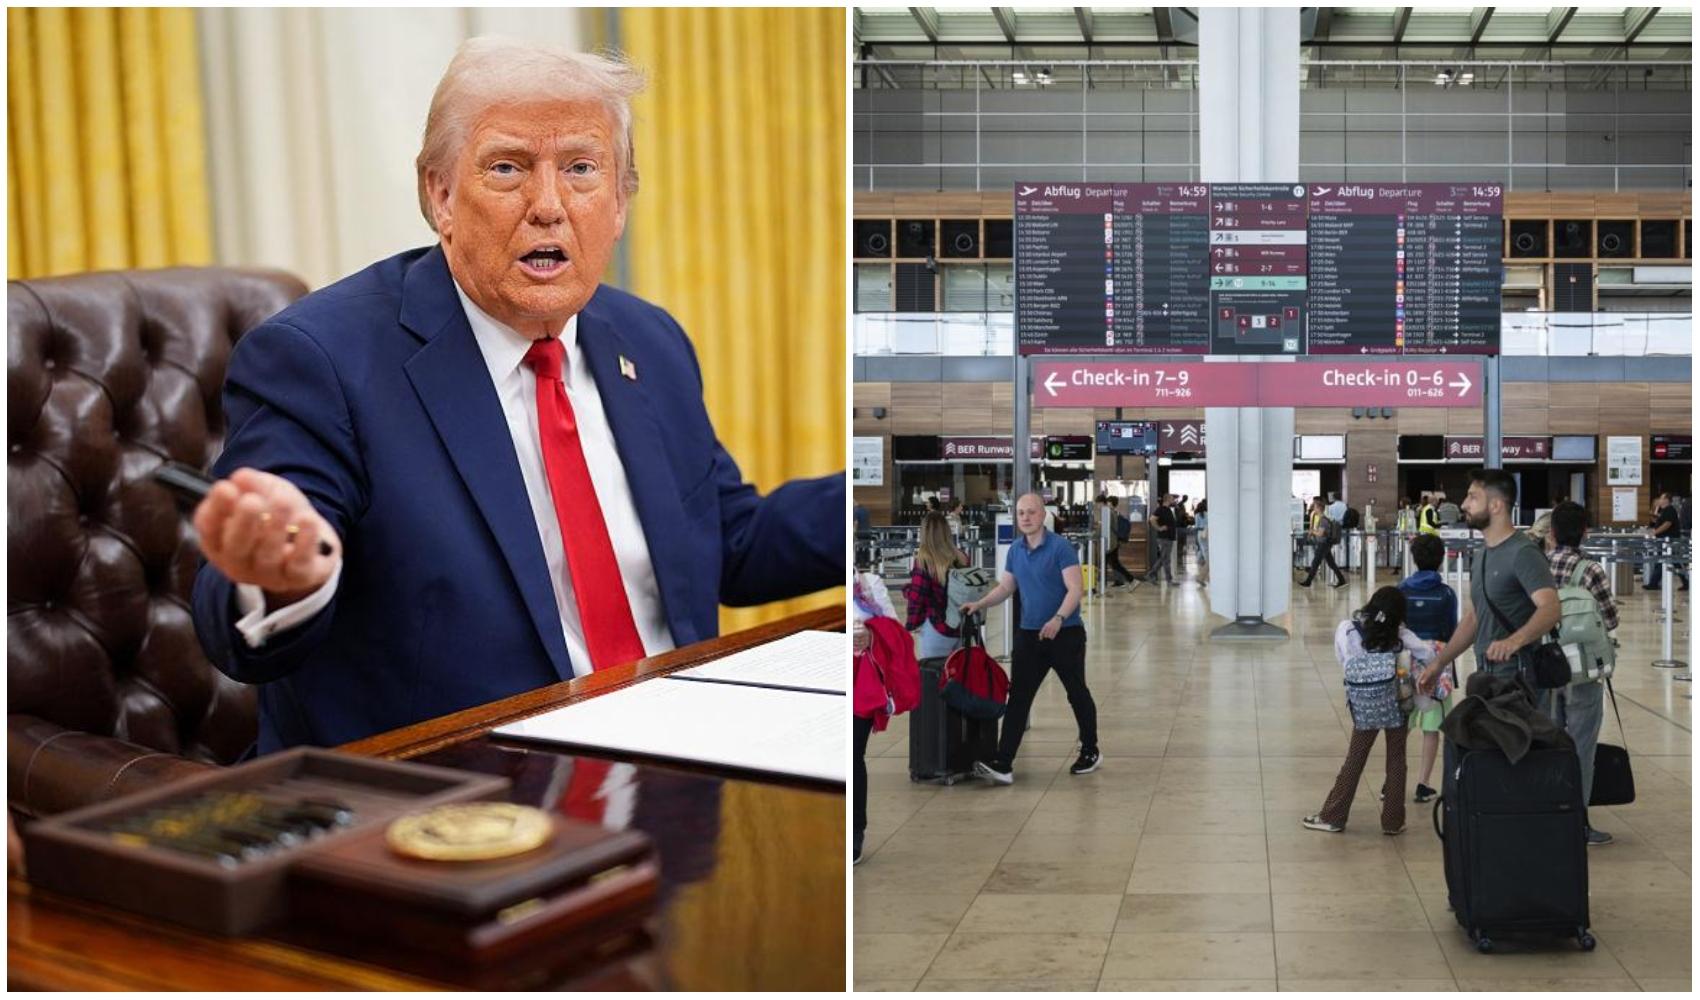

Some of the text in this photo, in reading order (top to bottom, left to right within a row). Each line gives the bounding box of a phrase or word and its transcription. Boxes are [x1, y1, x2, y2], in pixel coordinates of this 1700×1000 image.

[1044, 185, 1128, 199] Abflug Departure
[1178, 186, 1206, 197] 14:59
[1337, 186, 1422, 199] Abflug Departure
[1472, 186, 1500, 197] 14:59
[1072, 370, 1149, 386] Check-in
[1323, 370, 1400, 386] Check-in
[958, 445, 1014, 456] BER Runway
[1462, 445, 1480, 454] BER
